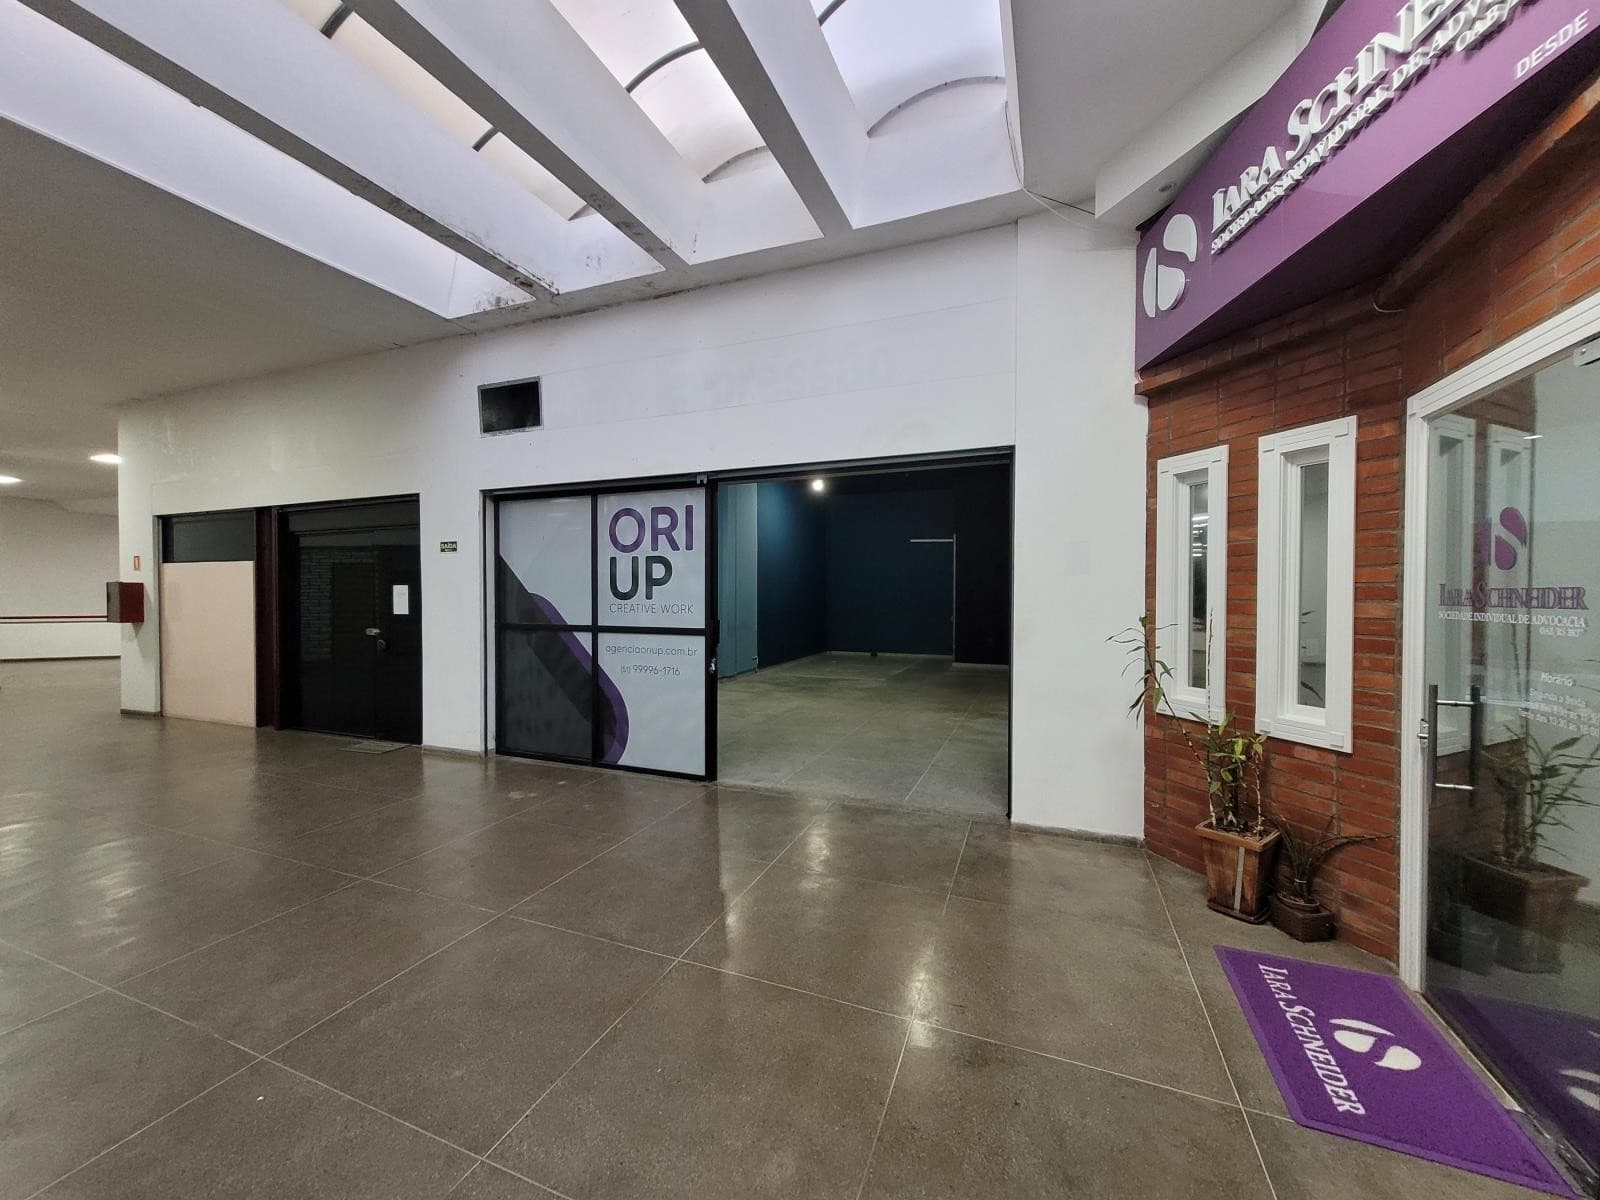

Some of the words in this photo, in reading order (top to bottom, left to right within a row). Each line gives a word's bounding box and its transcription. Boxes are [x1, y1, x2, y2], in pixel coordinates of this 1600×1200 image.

[1515, 9, 1590, 79] DESDE
[1211, 146, 1284, 233] IARA
[1285, 0, 1460, 161] SCHNE
[608, 505, 694, 553] ORI
[609, 555, 673, 601] UP
[1472, 582, 1590, 610] SCHNEIDER
[609, 603, 657, 614] CREATIVE
[660, 603, 694, 614] WORK
[1473, 612, 1517, 624] INDIVIDUAL
[1518, 614, 1530, 625] DE
[1531, 615, 1586, 628] ADVOCACIA
[605, 645, 698, 657] agenciaoriup.com.br
[632, 664, 681, 676] 99996-1716
[1258, 963, 1298, 1000] IARA
[1277, 1001, 1366, 1115] SCHNEIDER
